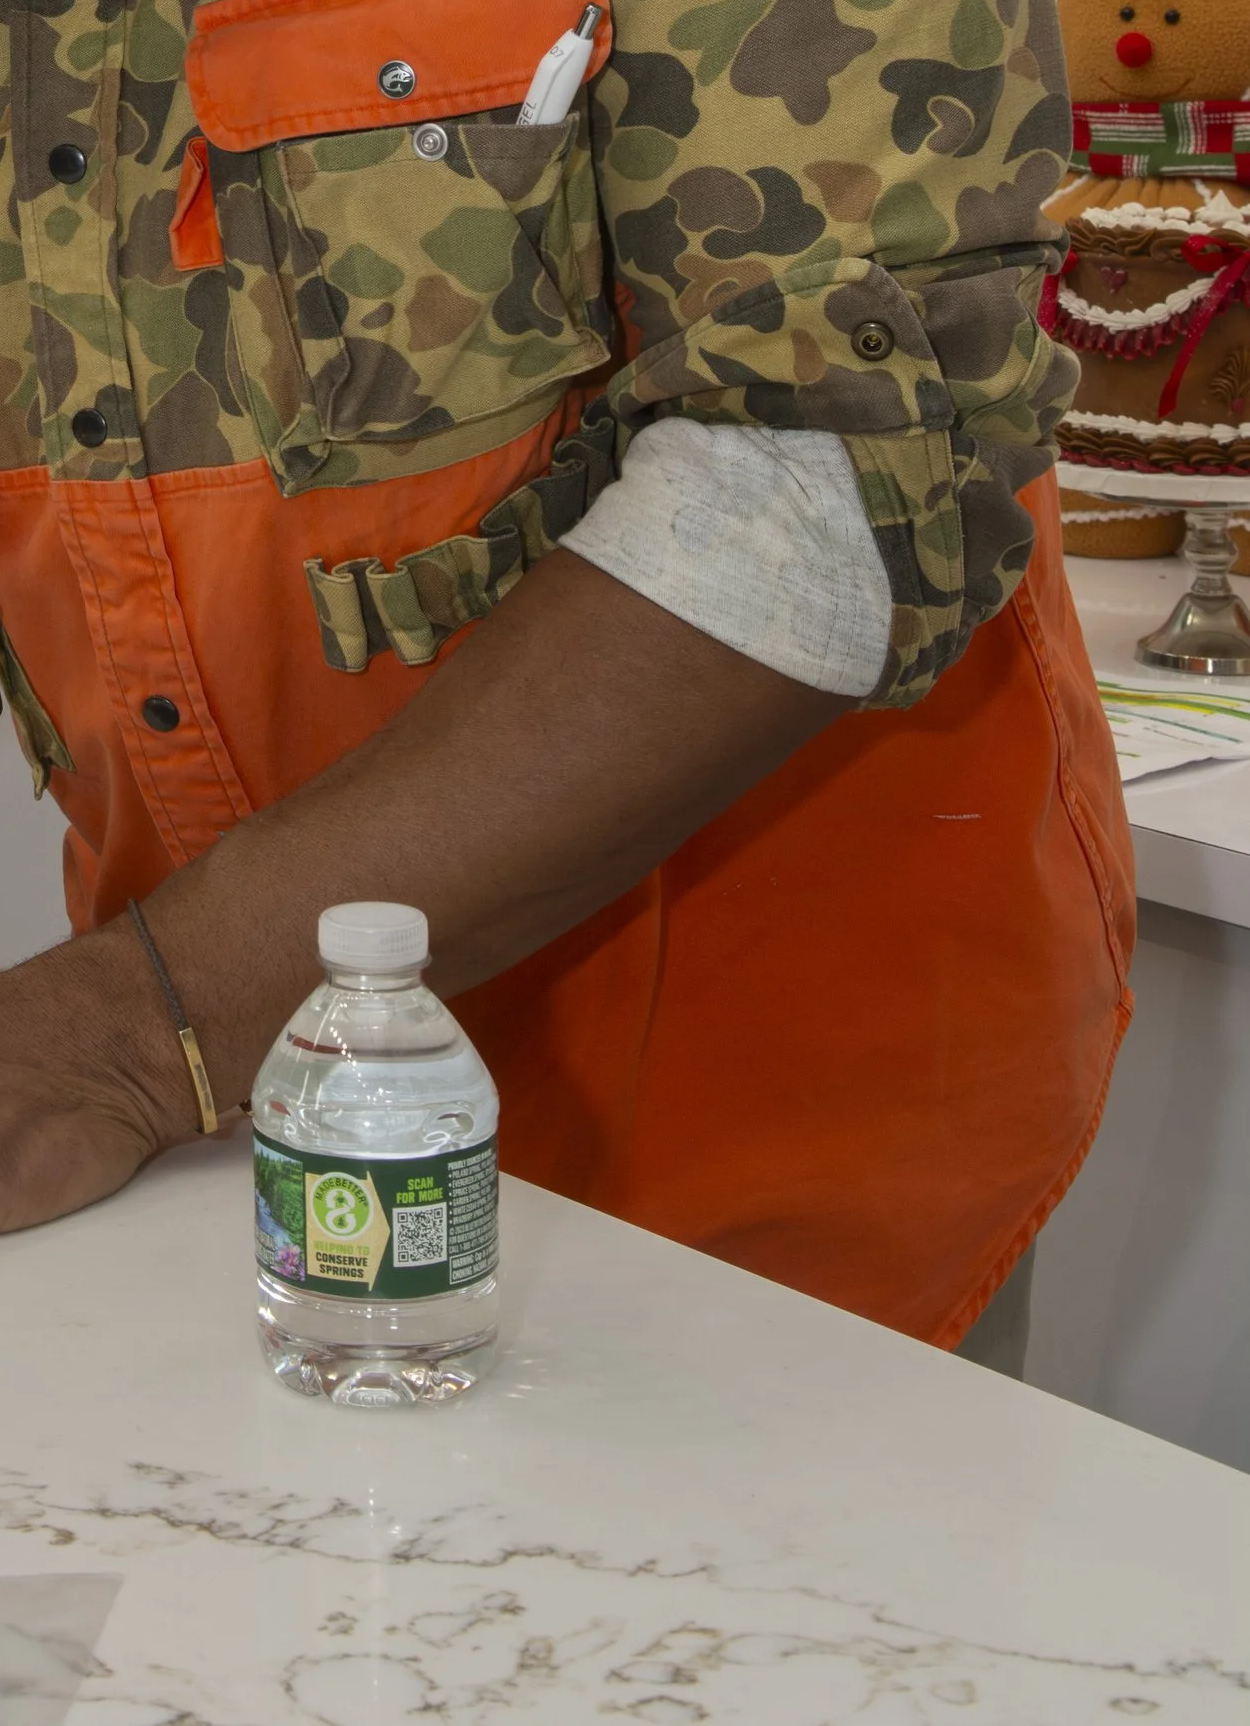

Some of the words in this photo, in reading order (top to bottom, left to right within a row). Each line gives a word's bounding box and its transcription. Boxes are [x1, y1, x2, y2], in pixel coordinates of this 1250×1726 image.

[407, 1176, 434, 1191] SCAN
[396, 1191, 415, 1204] FOR
[419, 1187, 443, 1202] MORE
[315, 1251, 369, 1267] CONSERVE
[319, 1263, 364, 1278] SPRINGS
